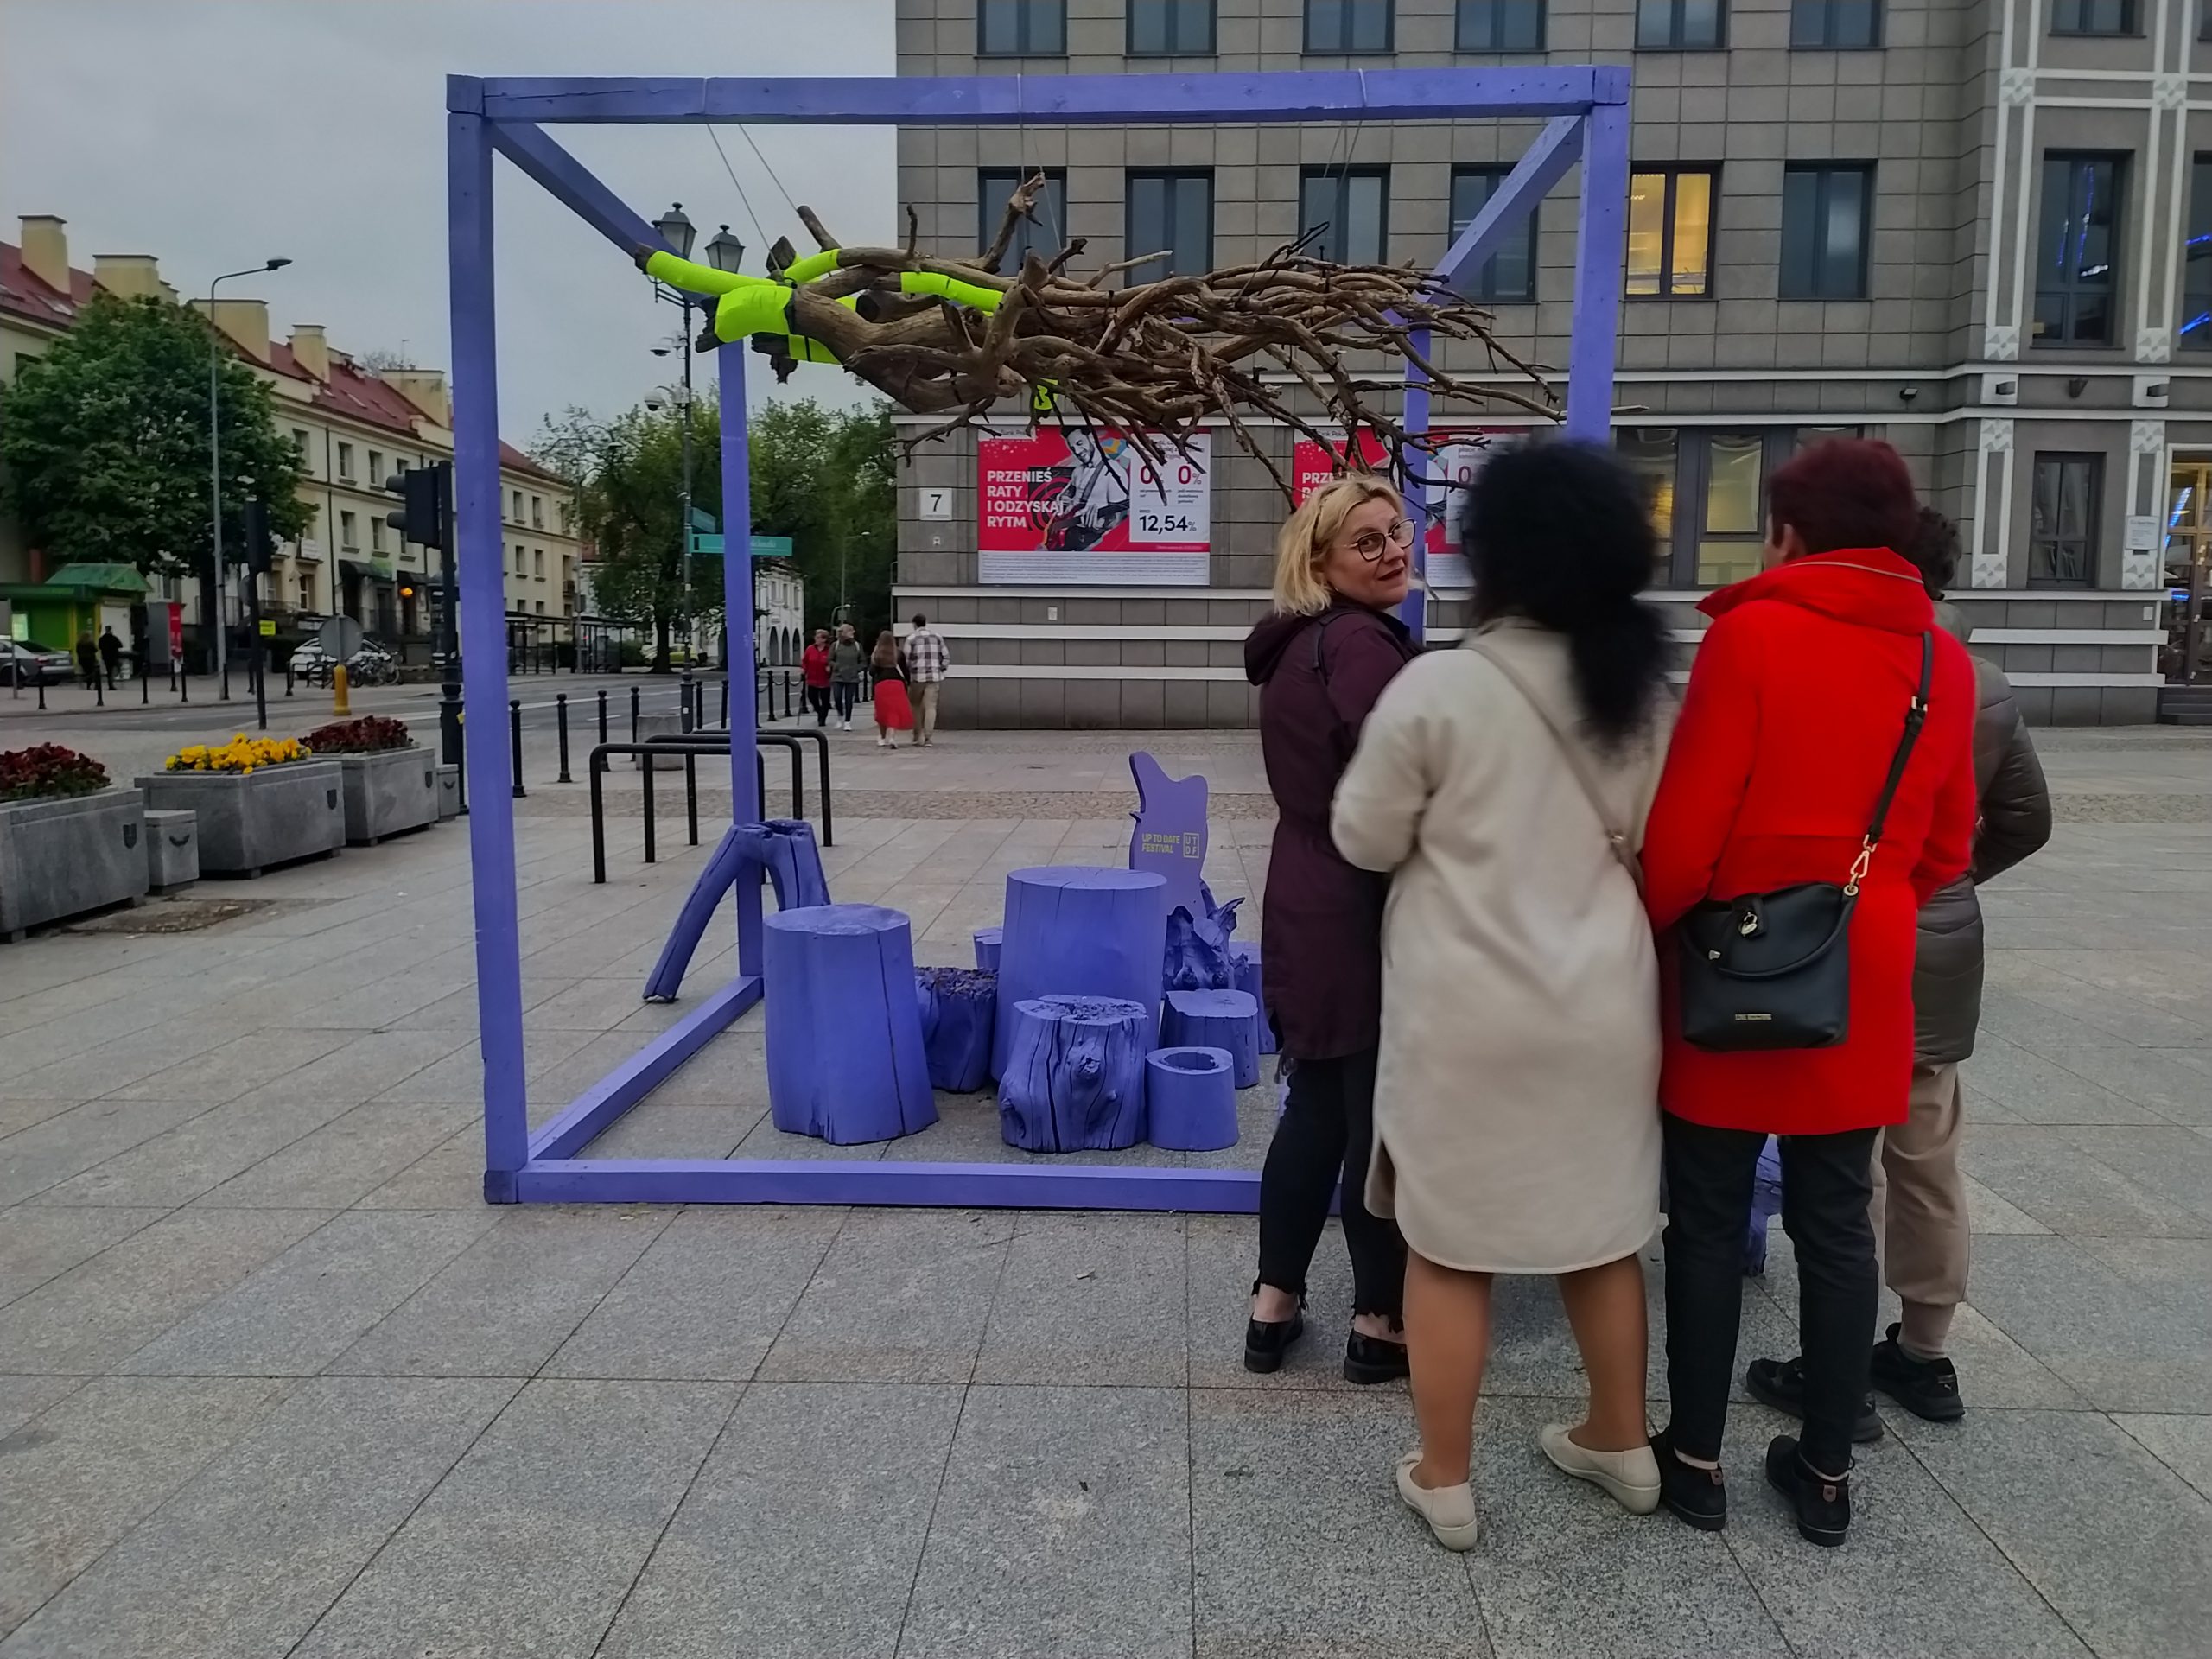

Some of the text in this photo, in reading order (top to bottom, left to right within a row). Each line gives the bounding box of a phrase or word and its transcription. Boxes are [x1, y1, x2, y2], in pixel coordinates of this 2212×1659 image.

[987, 467, 1052, 483] PRZENIEŚ
[1178, 465, 1202, 485] 0%
[987, 486, 1023, 498] RATY
[931, 493, 943, 512] 7
[987, 500, 1064, 516] I ODZYSKAJ
[987, 516, 1027, 528] RYTM
[1139, 514, 1198, 535] 12,54%
[1141, 833, 1180, 844] UP TO DATE
[1141, 843, 1173, 854] FESTIVAL
